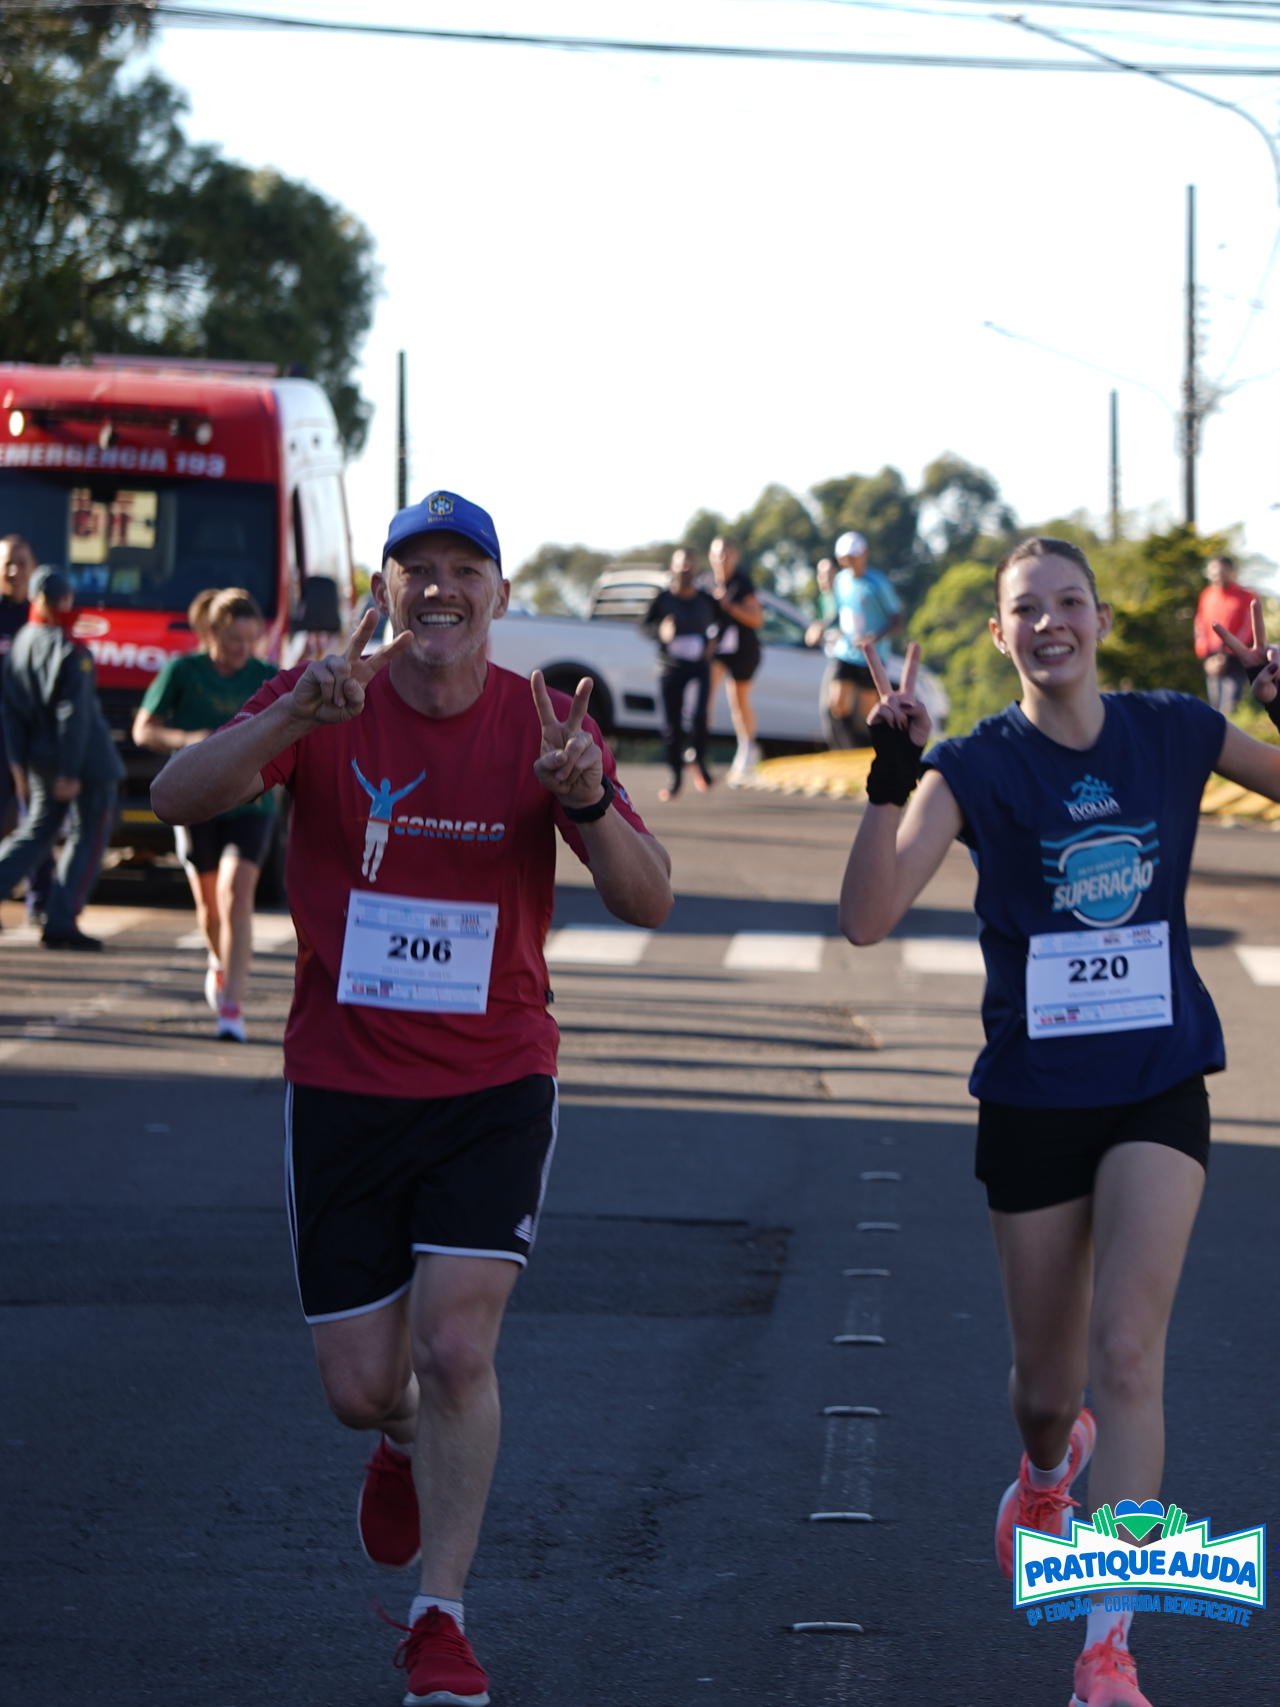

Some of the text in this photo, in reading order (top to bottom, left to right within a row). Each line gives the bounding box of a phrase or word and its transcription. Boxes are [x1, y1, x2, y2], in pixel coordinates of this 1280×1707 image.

[175, 451, 226, 478] 193
[1067, 796, 1120, 816] EVOLUA
[1053, 858, 1153, 909] SUPERAÇÃO
[387, 934, 452, 964] 206
[1068, 955, 1129, 984] 220
